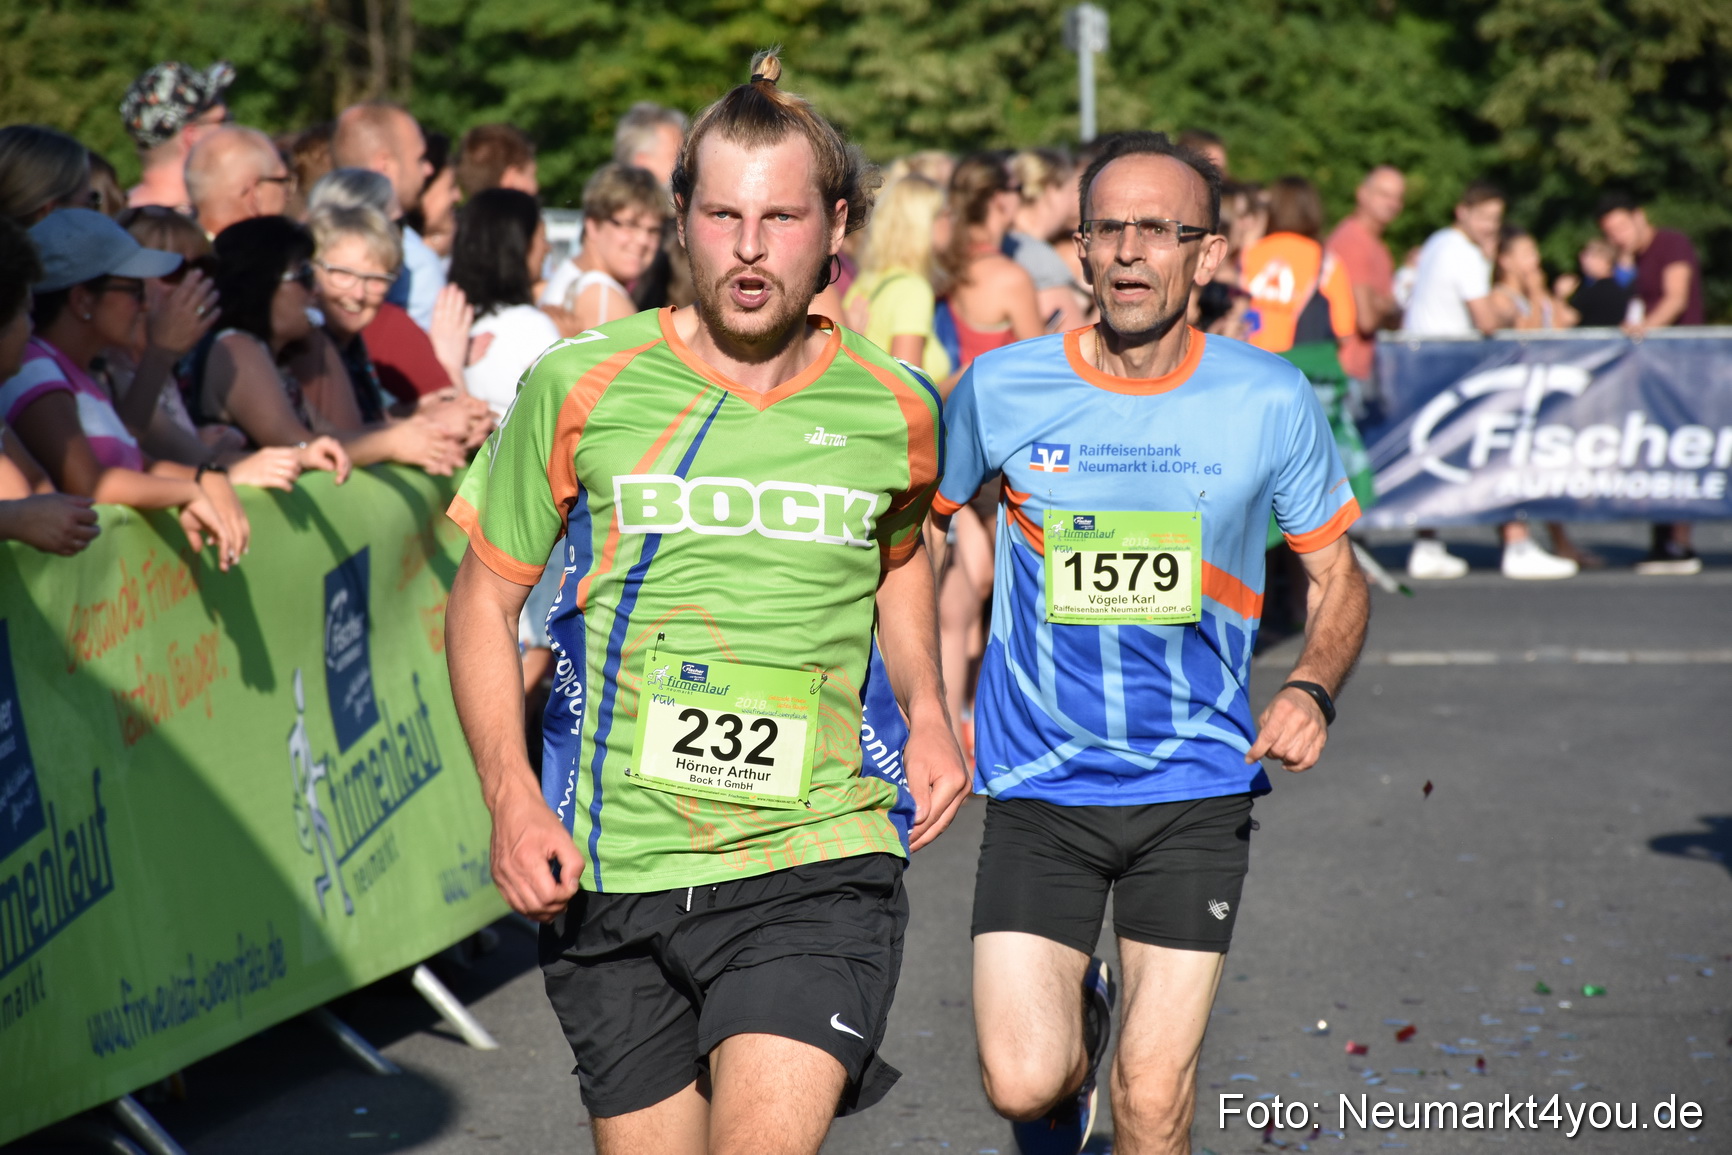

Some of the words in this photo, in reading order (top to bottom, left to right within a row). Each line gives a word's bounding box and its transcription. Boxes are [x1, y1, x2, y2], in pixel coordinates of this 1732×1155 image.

[1079, 443, 1181, 457] Raiffeisenbank
[1078, 460, 1147, 473] Neumarkt
[1203, 463, 1222, 476] eG
[1500, 470, 1726, 500] AUTOMOBILE
[612, 474, 879, 548] BOCK
[1064, 529, 1115, 538] firmenlauf
[1064, 552, 1179, 592] 1579
[1053, 605, 1108, 613] Raiffeisenbank
[1088, 595, 1128, 606] Vögele
[1132, 595, 1155, 604] Karl
[667, 676, 730, 696] firmenlauf
[735, 696, 767, 710] 2018
[672, 708, 779, 767] 232
[323, 672, 443, 855] firmenlauf
[676, 757, 724, 775] Hörner
[727, 766, 771, 781] Arthur
[690, 774, 713, 785] Bock
[724, 780, 753, 790] GmbH
